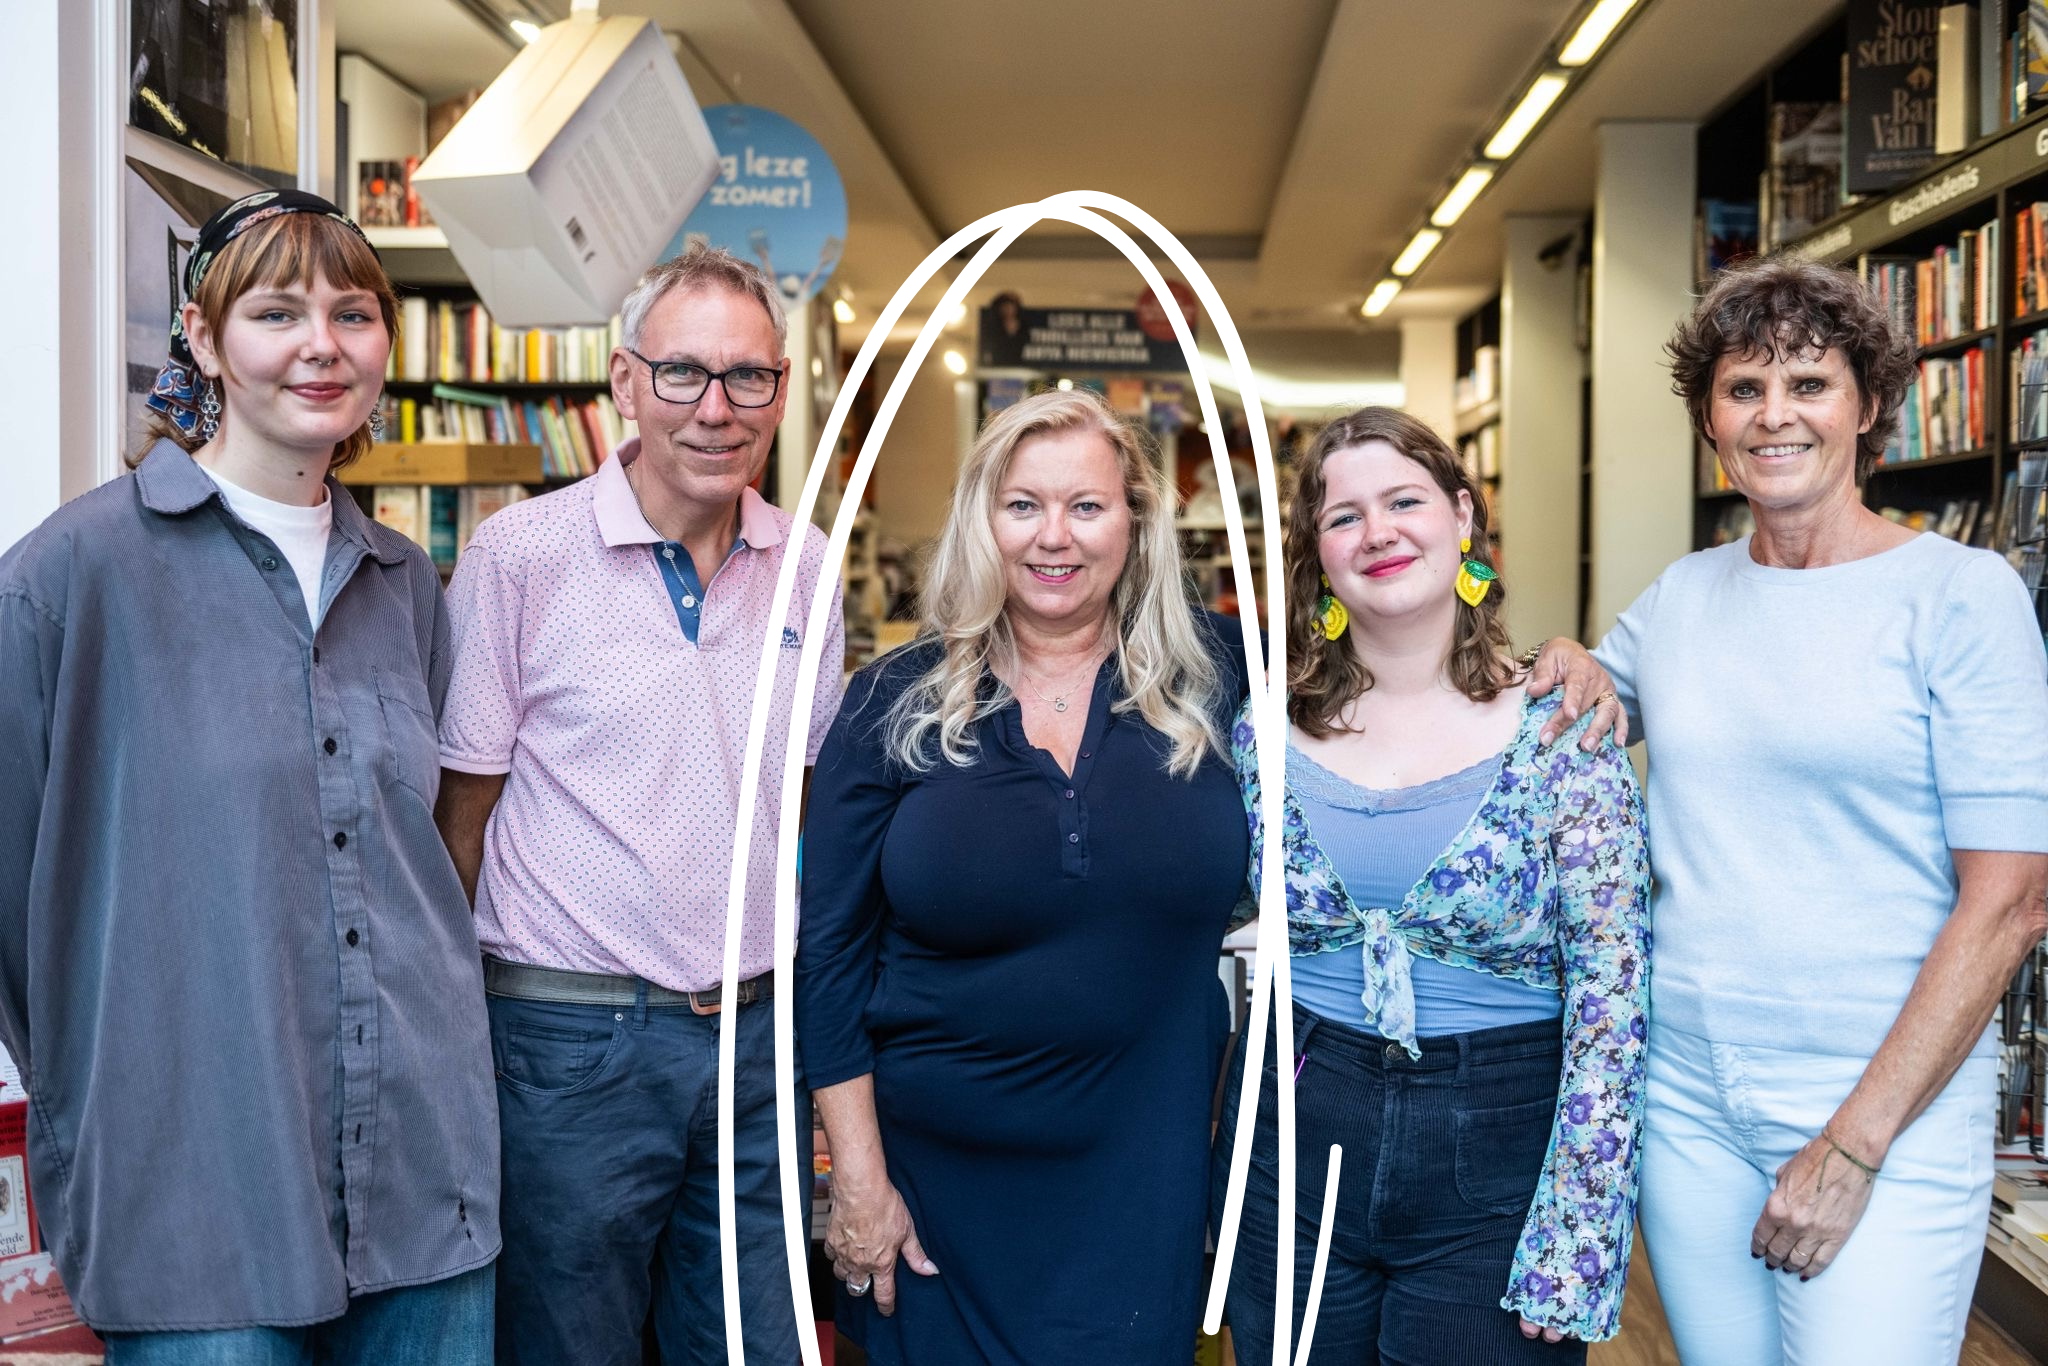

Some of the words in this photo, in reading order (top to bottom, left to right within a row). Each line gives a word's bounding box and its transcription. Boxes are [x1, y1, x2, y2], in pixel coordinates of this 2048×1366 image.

[1878, 0, 1938, 37] Stou
[1857, 35, 1938, 68] schoe
[1892, 86, 1937, 125] Bar
[745, 145, 808, 178] leze
[710, 179, 812, 208] zomer!
[1889, 164, 1980, 226] Geschiedenis
[0, 1231, 25, 1247] ende
